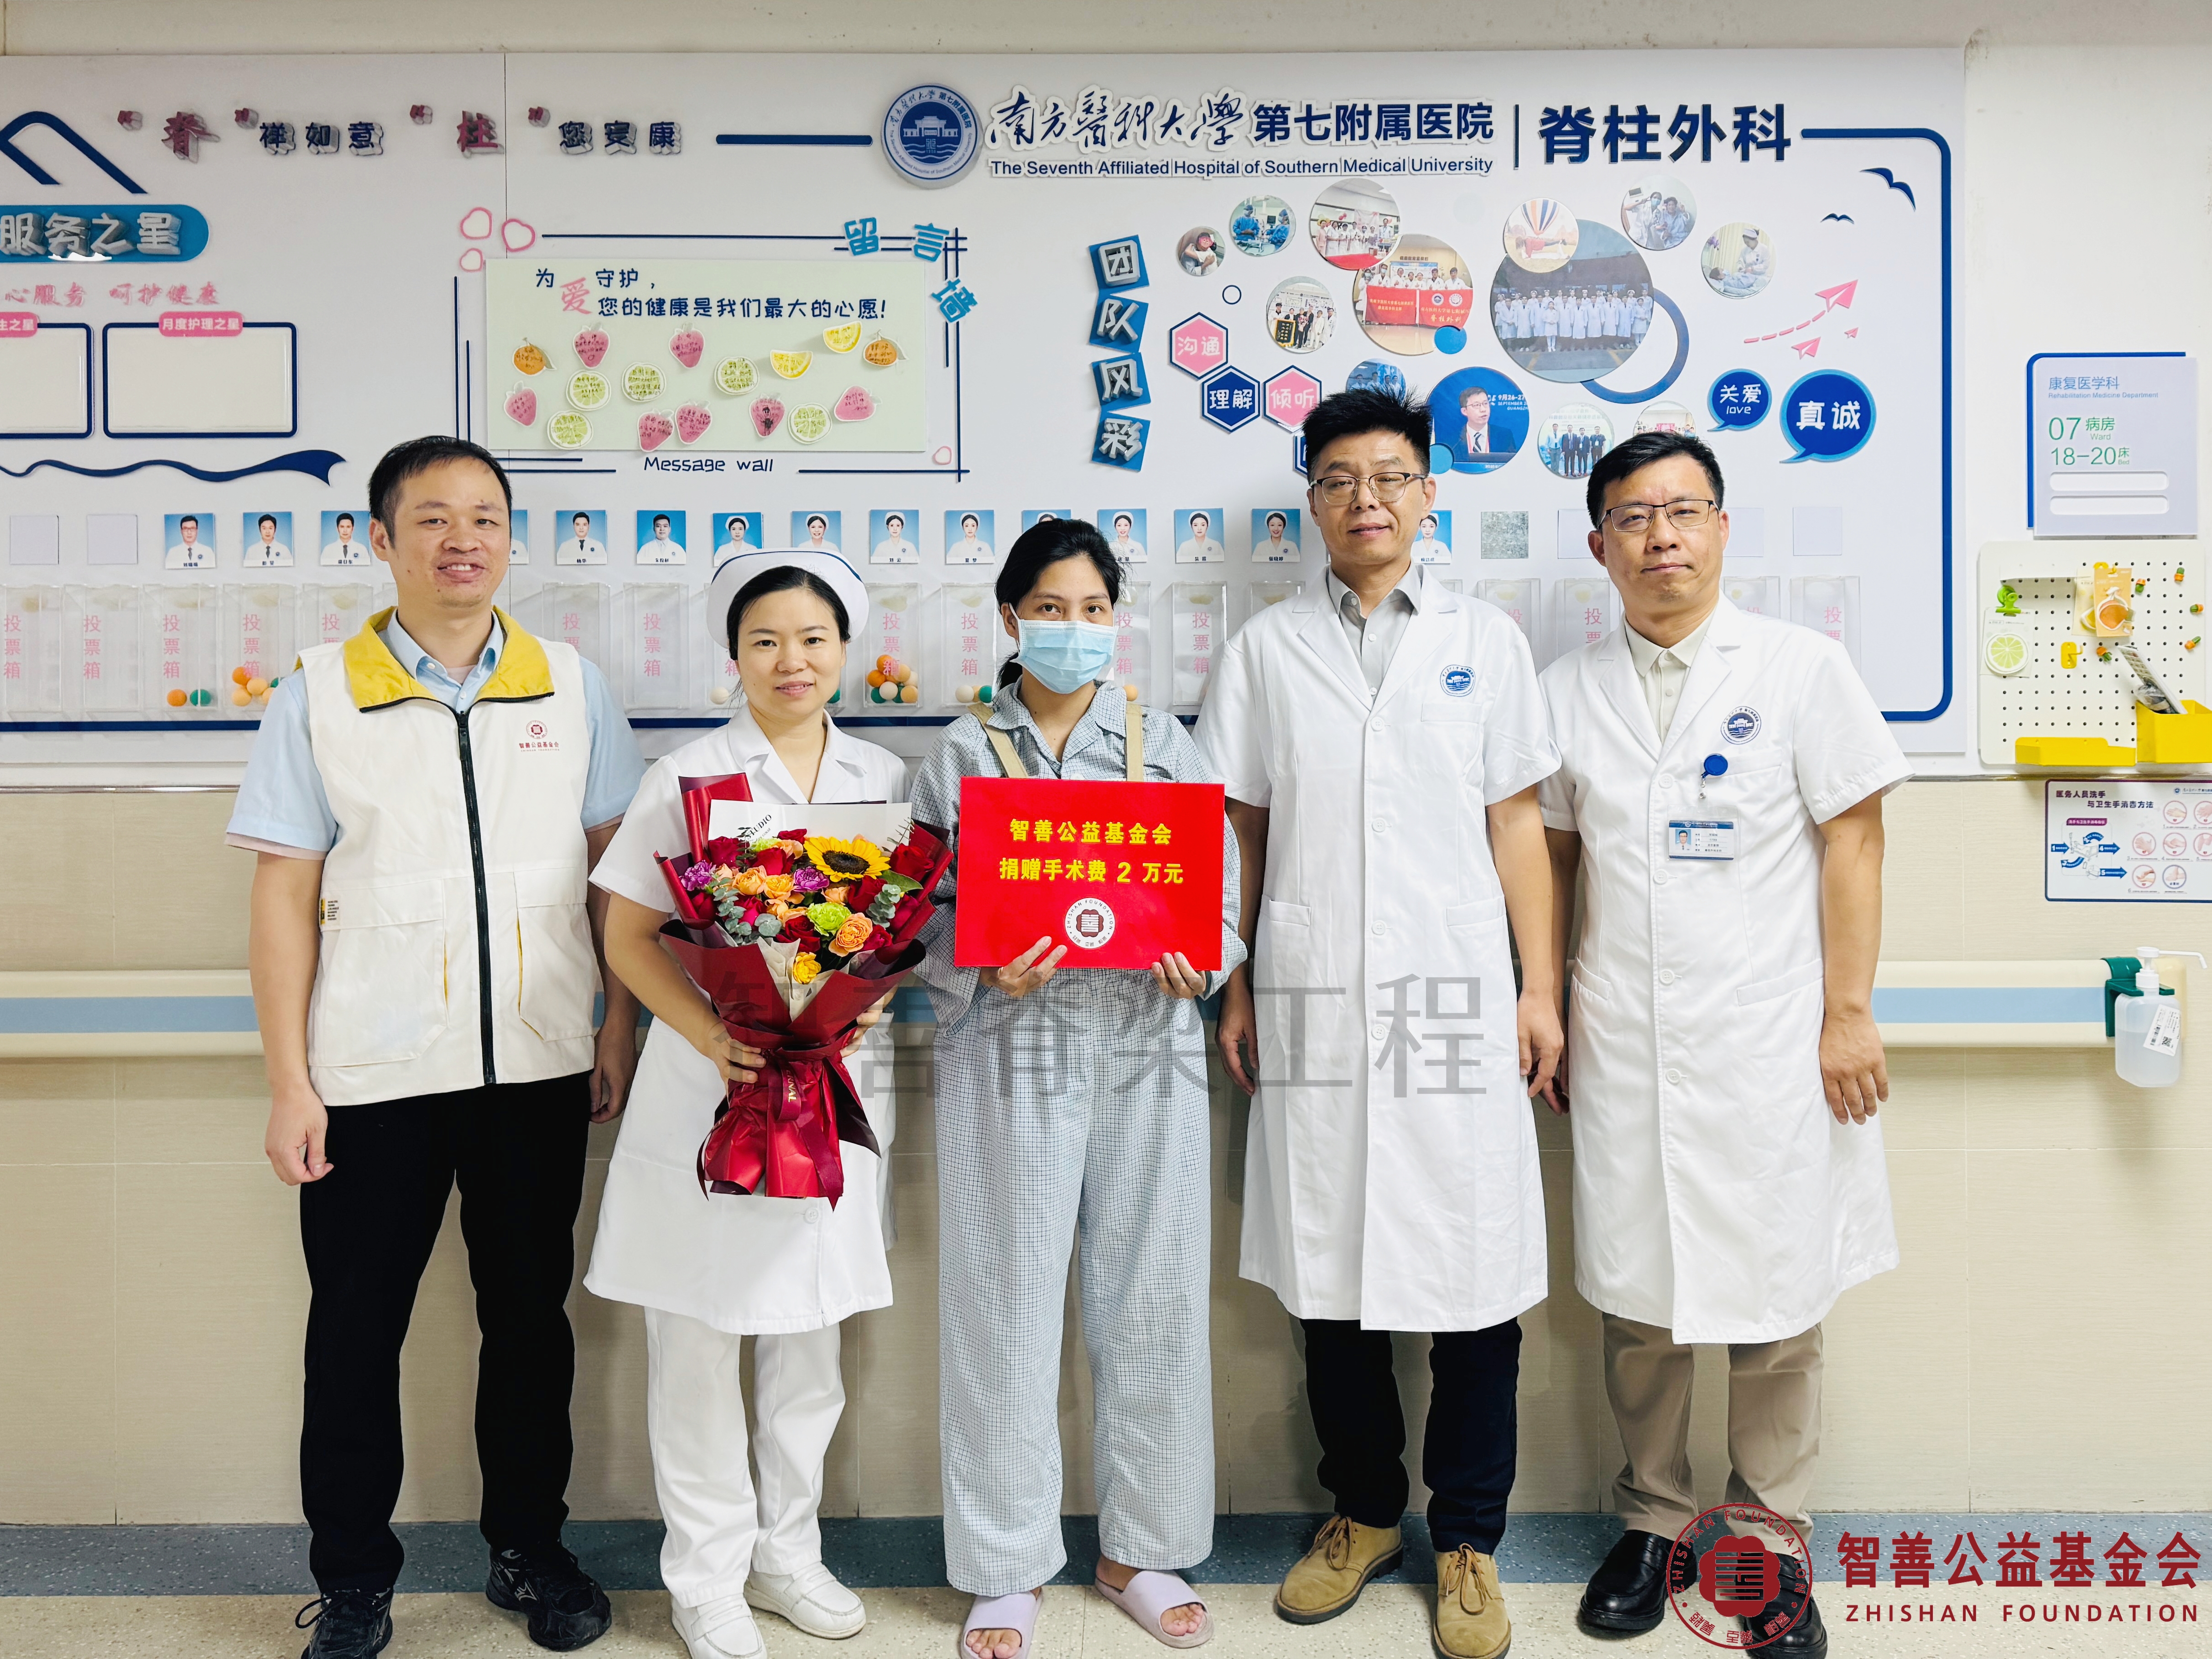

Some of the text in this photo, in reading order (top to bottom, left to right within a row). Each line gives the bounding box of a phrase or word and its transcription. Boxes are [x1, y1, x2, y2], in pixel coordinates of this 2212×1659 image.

[1253, 102, 1494, 143] 第七附属医院
[1539, 104, 1791, 164] 脊柱外科
[991, 158, 1494, 178] The Seventh Affiliated Hospital of Southern Medical University
[0, 211, 181, 256] 服务之星
[162, 318, 240, 331] 月度护理之星
[1176, 336, 1221, 357] 沟通
[1719, 384, 1762, 404] 关爱
[2049, 376, 2120, 390] 康复医学科
[1208, 389, 1254, 410] 理解
[1270, 388, 1314, 410] 倾听
[1726, 405, 1752, 416] love
[1796, 400, 1861, 430] 真诚
[2048, 417, 2115, 440] 07 病房
[644, 457, 774, 473] Message wall
[2051, 447, 2130, 465] 18-20 床
[4, 614, 22, 679] 投票箱
[83, 614, 101, 679] 投票箱
[163, 614, 181, 678] 投票箱
[242, 614, 261, 678] 投票箱
[643, 612, 661, 677] 投票箱
[961, 612, 978, 676] 投票箱
[1115, 612, 1133, 674] 投票箱
[1192, 611, 1210, 674] 投票箱
[2056, 790, 2106, 798] 医务人员洗手
[2087, 800, 2154, 809] 与卫生手消毒方法
[1010, 818, 1172, 845] 智善公益基金会
[999, 857, 1184, 885] 捐赠手术费 2 万元
